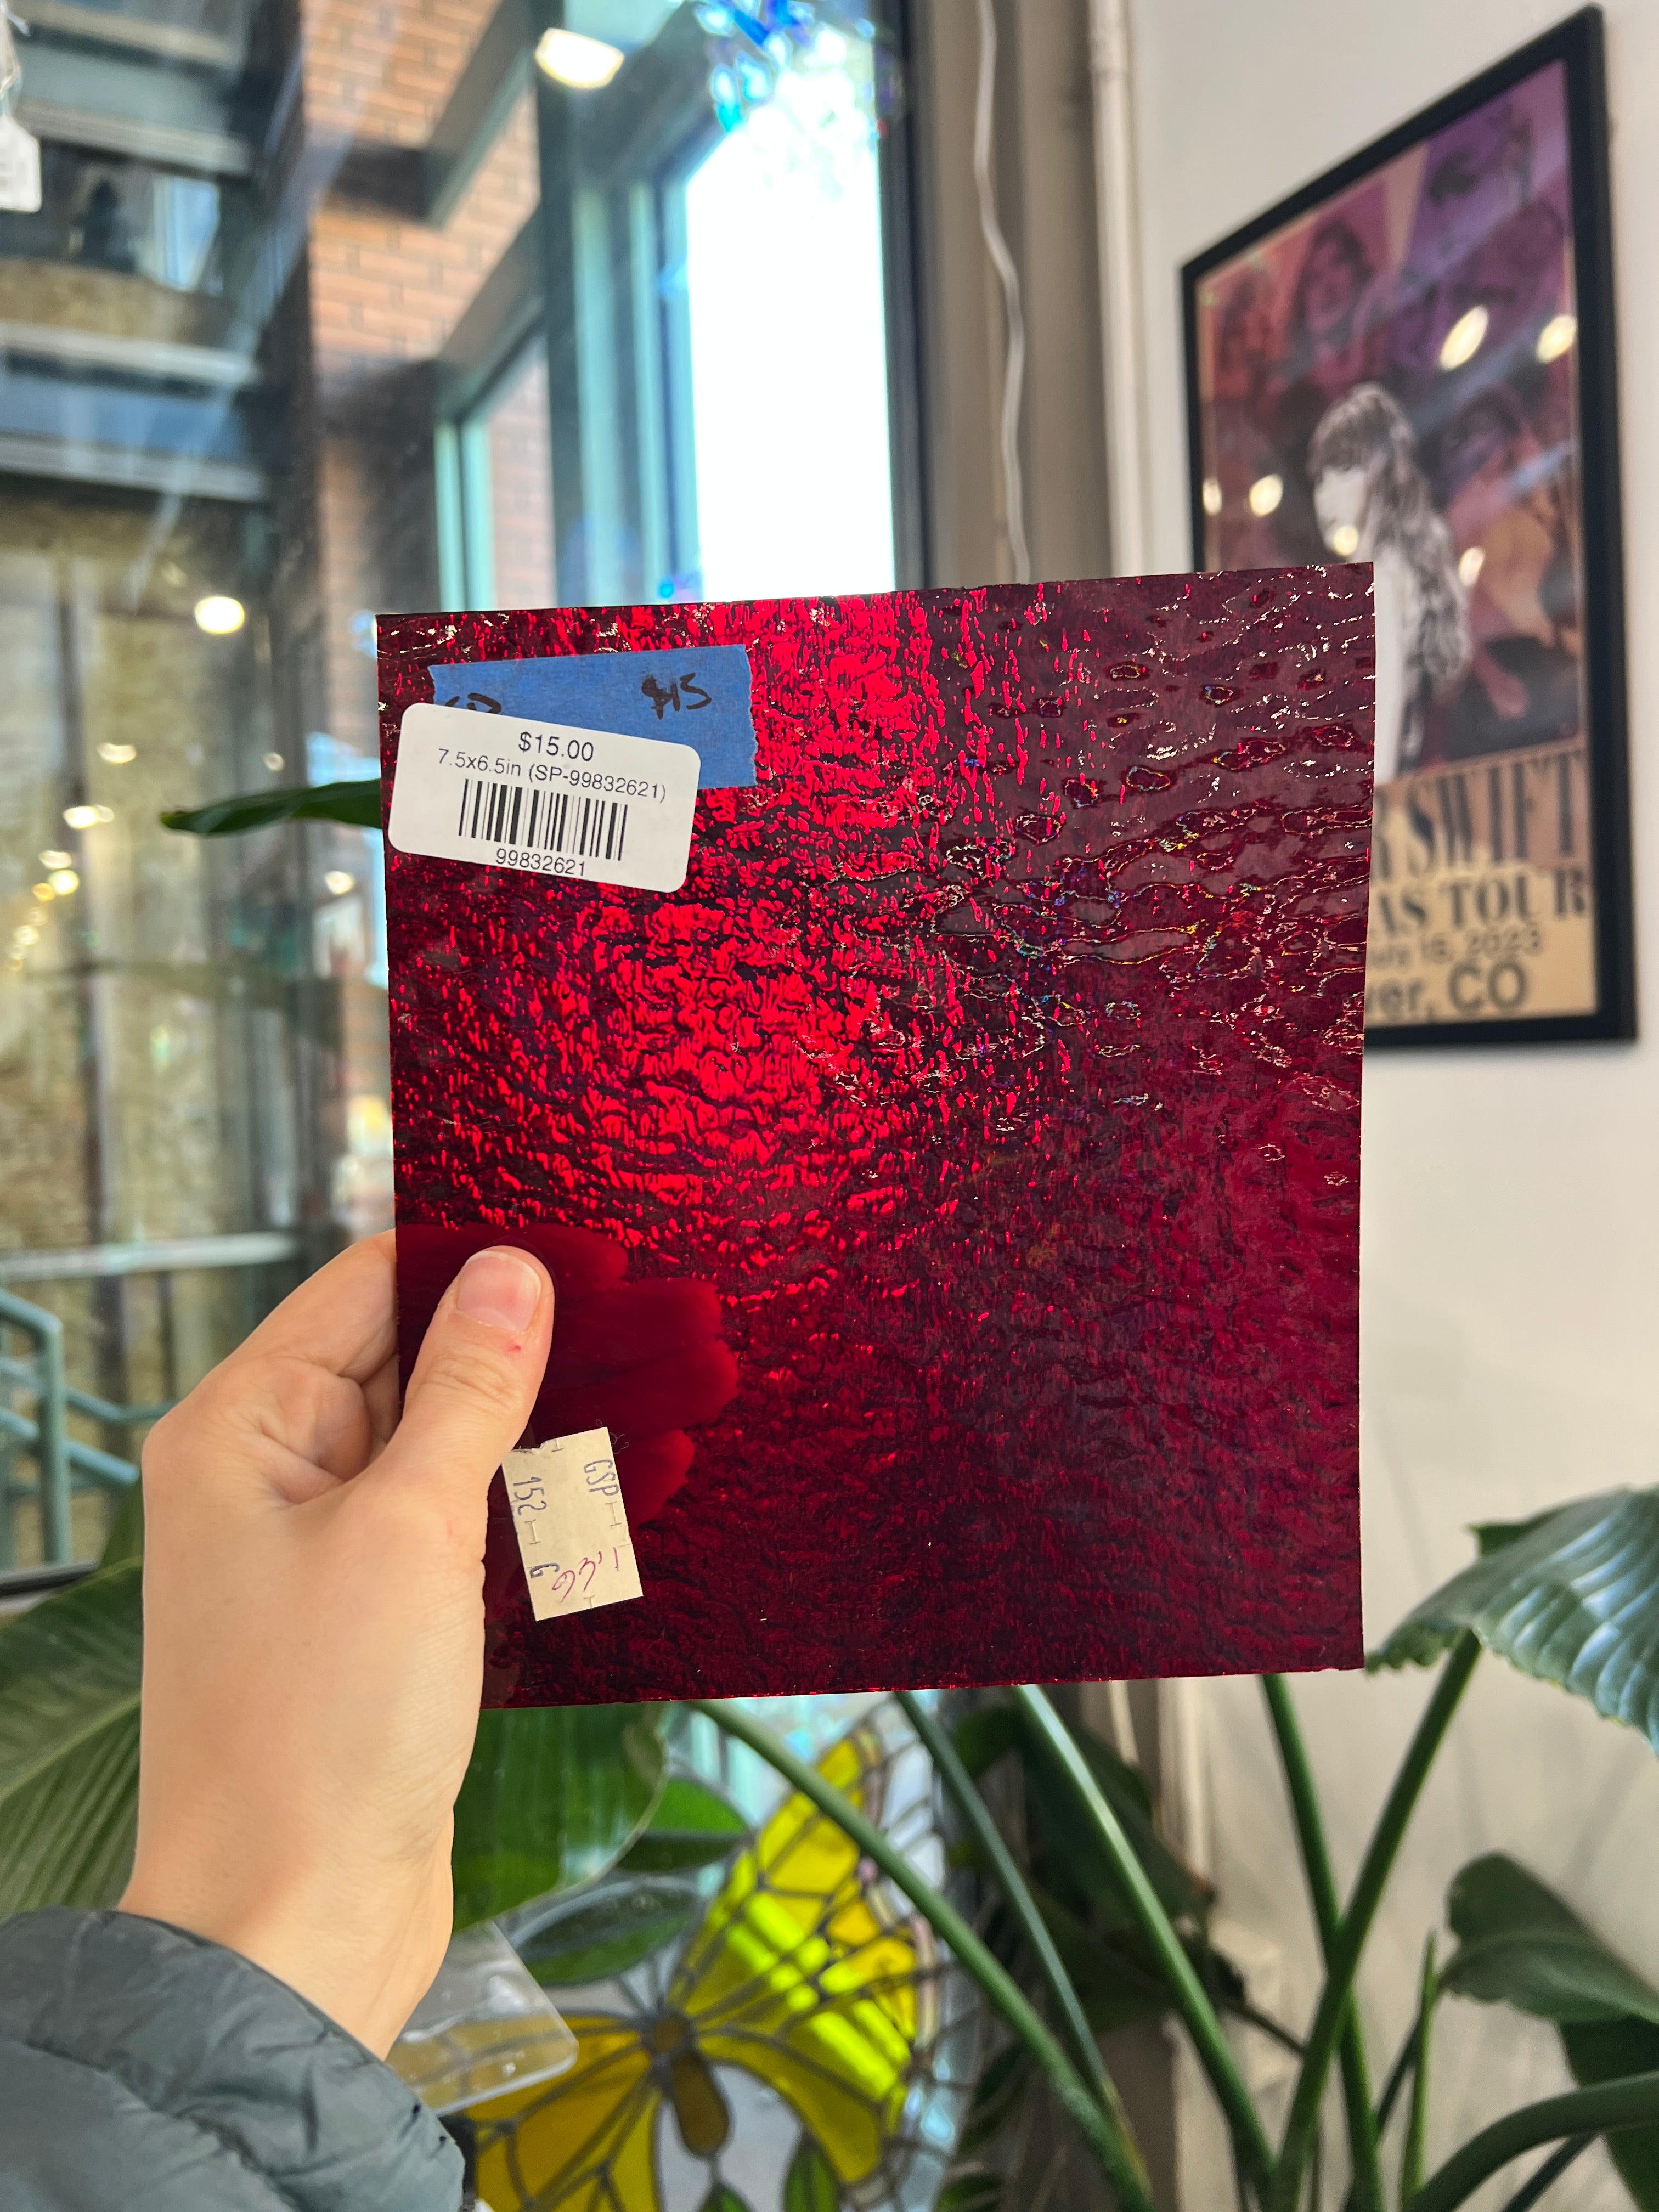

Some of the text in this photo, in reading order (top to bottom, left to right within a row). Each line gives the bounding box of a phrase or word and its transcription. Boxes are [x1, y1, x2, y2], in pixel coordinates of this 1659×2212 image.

[518, 731, 594, 761] $15.00
[438, 748, 666, 803] 7.5x6.5in (SP-99832621)
[1404, 749, 1585, 873] SWIFT
[495, 848, 586, 877] 99832621
[1373, 867, 1588, 936] AS TOUR
[1447, 960, 1529, 1014] CO
[512, 1476, 547, 1516] 152
[583, 1459, 619, 1497] GSP
